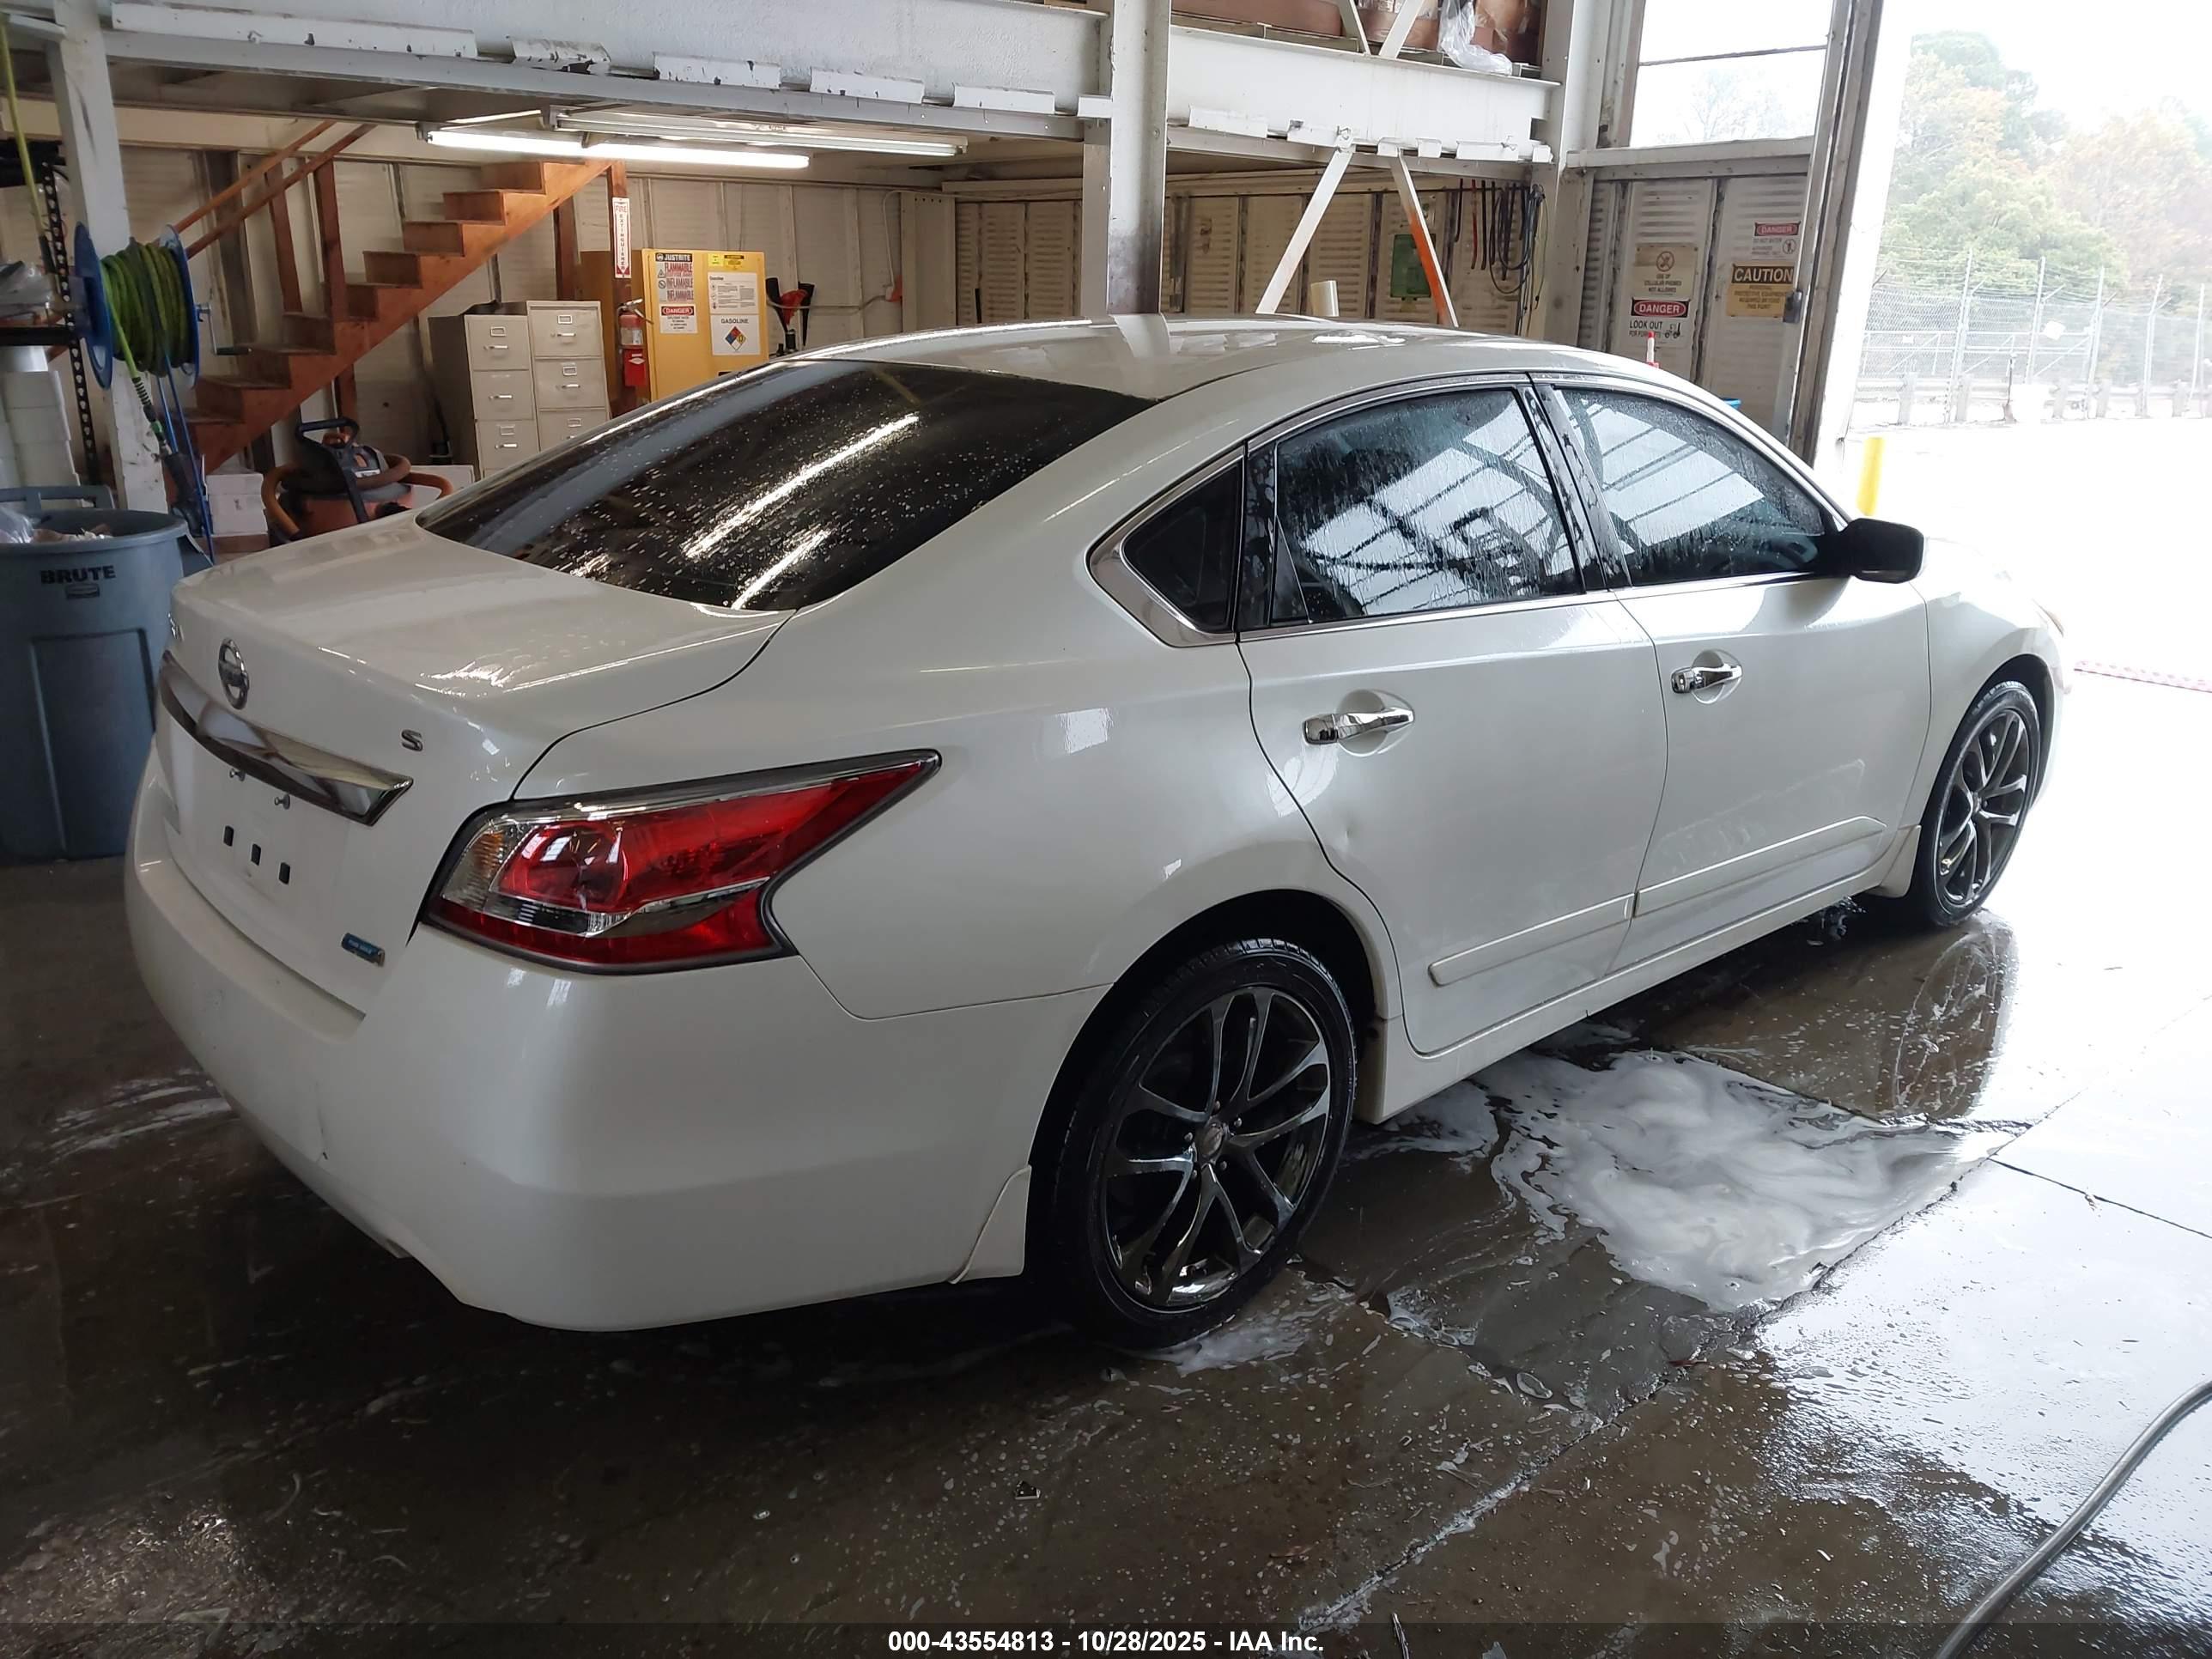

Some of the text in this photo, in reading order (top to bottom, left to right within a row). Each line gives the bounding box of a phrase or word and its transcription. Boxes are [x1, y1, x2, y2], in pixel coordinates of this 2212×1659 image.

[664, 253, 691, 262] JUSTRITE
[1734, 268, 1795, 283] CAUTION
[1639, 304, 1680, 314] DANGER
[1630, 320, 1648, 329] LOOK
[40, 565, 116, 584] BRUTE
[401, 729, 423, 752] S
